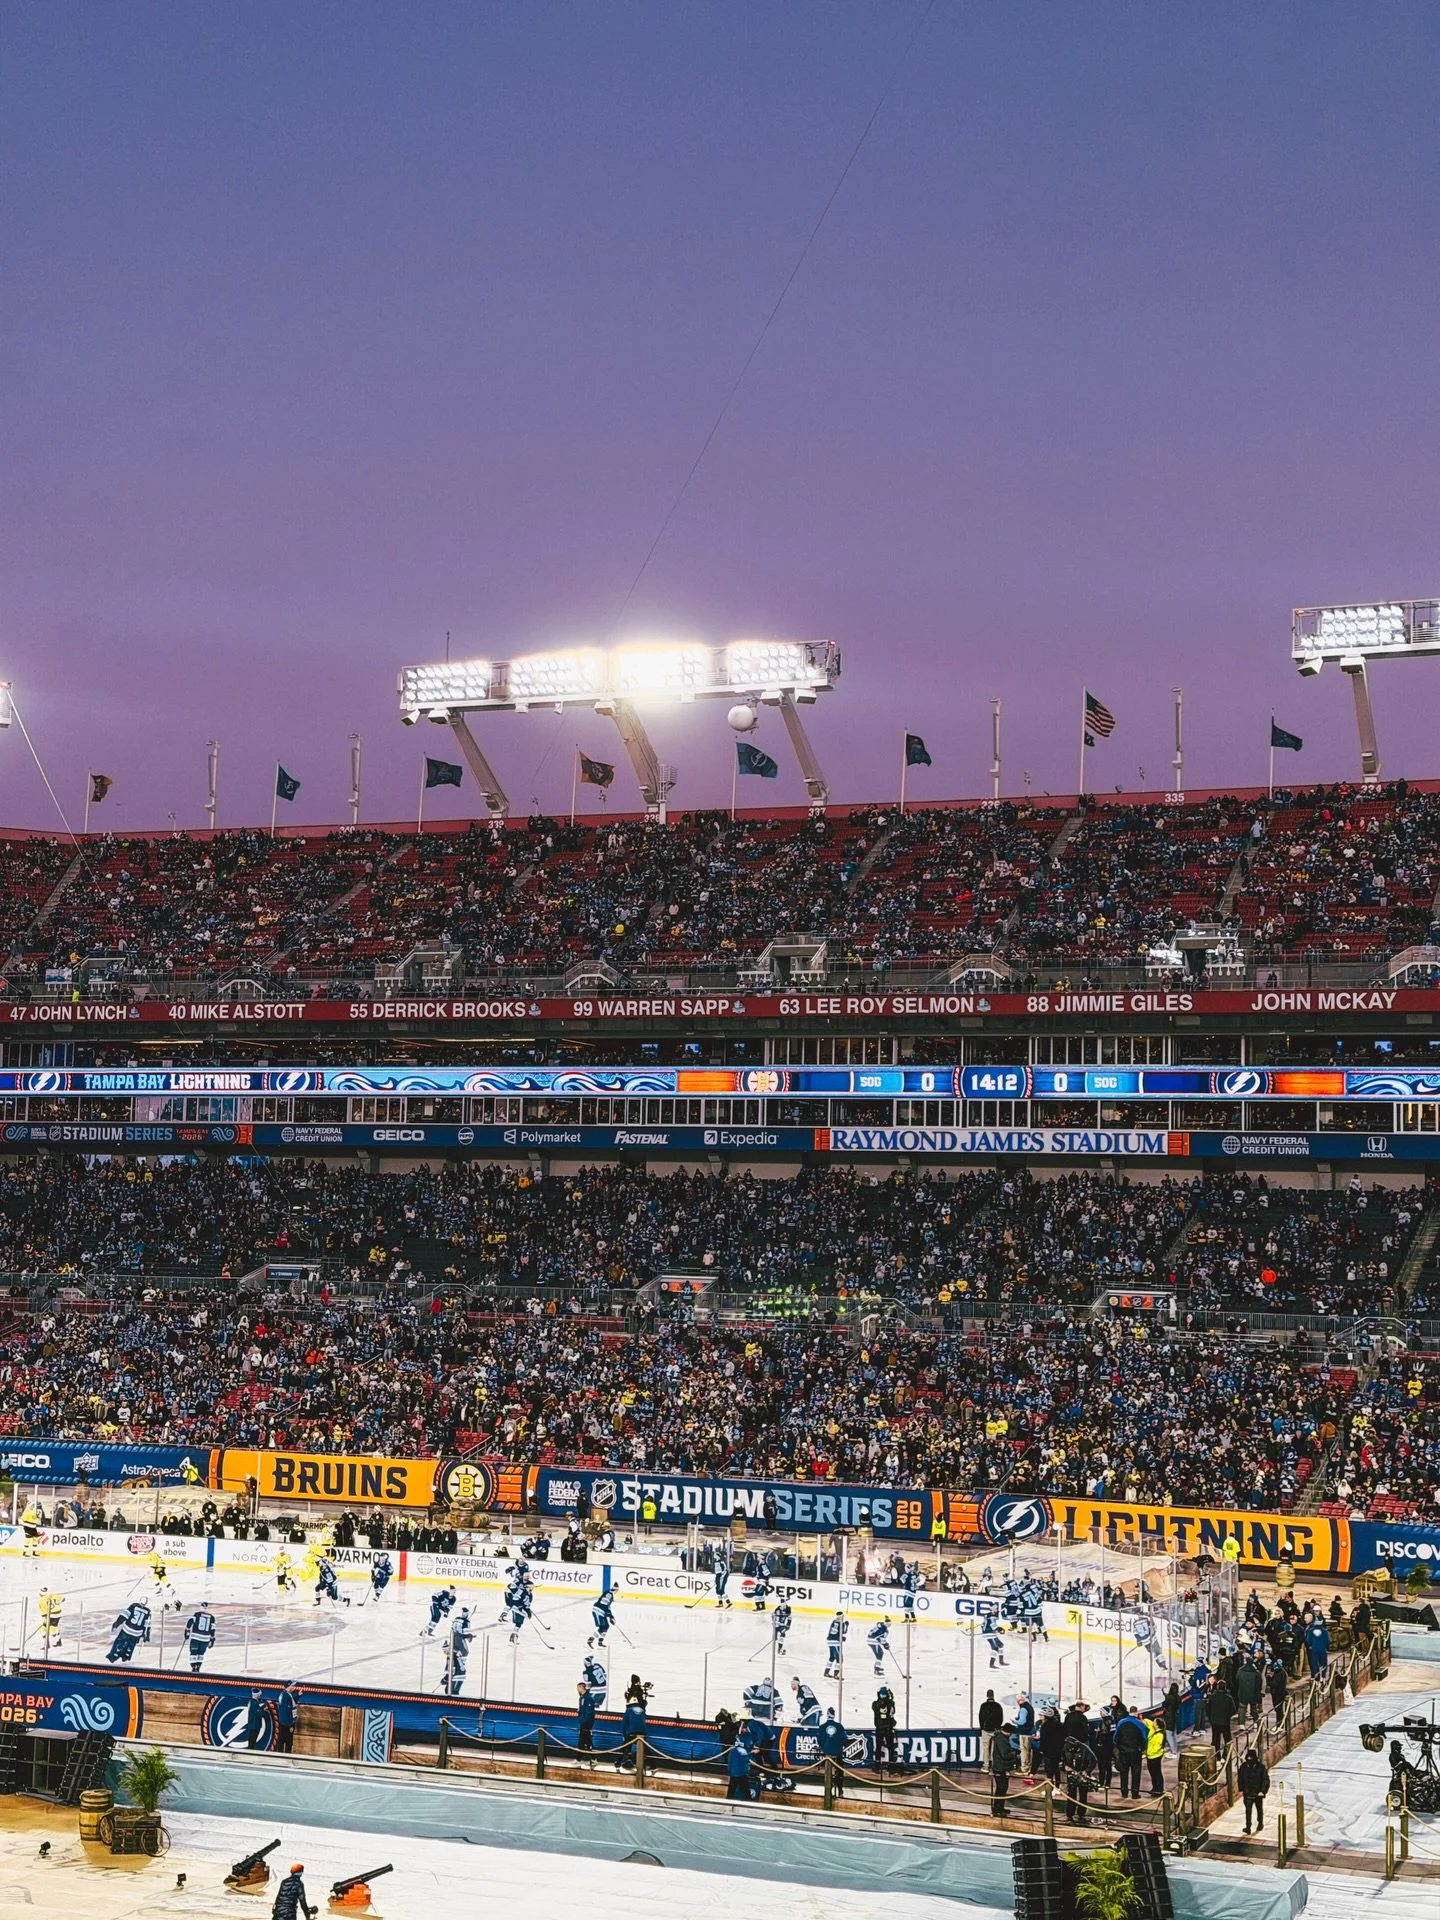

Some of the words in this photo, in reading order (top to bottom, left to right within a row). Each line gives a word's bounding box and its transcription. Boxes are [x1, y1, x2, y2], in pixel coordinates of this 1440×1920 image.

[1164, 792, 1185, 803] 335
[573, 1001, 593, 1017] 99
[599, 1000, 676, 1016] WARREN
[681, 999, 730, 1015] SAPP
[779, 999, 800, 1014] 63
[805, 998, 841, 1014] LEE
[847, 997, 887, 1013] ROY
[892, 997, 974, 1014] SELMON
[1027, 996, 1049, 1012] 88
[1055, 995, 1124, 1012] JIMMIE
[1130, 994, 1193, 1011] GILES
[1251, 993, 1311, 1011] JOHN
[1318, 992, 1397, 1010] MCKAY
[10, 1006, 27, 1020] 47
[30, 1005, 72, 1021] JOHN
[76, 1005, 127, 1020] LYNCH
[168, 1005, 186, 1019] 40
[190, 1004, 229, 1019] MIKE
[232, 1003, 306, 1019] ALSTOTT
[350, 1003, 368, 1018] 55
[372, 1002, 447, 1018] DERRICK
[452, 1002, 526, 1018] BROOKS
[84, 1074, 135, 1090] TAMPA
[138, 1074, 166, 1090] BAY
[170, 1073, 251, 1090] LIGHTNING
[860, 1076, 882, 1088] SOG
[921, 1072, 935, 1091] 0
[971, 1074, 1017, 1091] 14:12
[1054, 1072, 1068, 1091] 0
[1094, 1076, 1117, 1088] SOG
[63, 1126, 123, 1140] STADIUM
[125, 1126, 173, 1140] SERIES
[373, 1129, 425, 1141] GEICO
[521, 1131, 581, 1144] Polymarket
[615, 1131, 668, 1144] FASTENAL
[720, 1131, 777, 1146] Expedia
[1242, 1136, 1266, 1144] NAVY
[1269, 1136, 1309, 1145] FEDERAL
[832, 1130, 957, 1151] RAYMOND
[961, 1131, 1044, 1152] JAMES
[1051, 1132, 1165, 1154] STADIUM
[1242, 1146, 1276, 1154] CREDIT
[1278, 1147, 1309, 1155] UNION
[272, 1457, 407, 1499] BRUINS
[457, 1473, 475, 1497] B
[549, 1480, 571, 1489] NAVY
[549, 1488, 580, 1497] FEDERA
[596, 1484, 613, 1502] NHL
[621, 1481, 766, 1519] STADIUM
[548, 1499, 566, 1507] Credit
[896, 1500, 921, 1515] 20
[896, 1515, 921, 1529] 26
[52, 1532, 104, 1546] paloalto
[1061, 1506, 1314, 1564] LIGHTNING
[172, 1539, 186, 1547] sub
[163, 1547, 187, 1556] above
[435, 1556, 459, 1567] NAVY
[461, 1558, 498, 1569] FEDERAL
[435, 1567, 463, 1578] CREDIT
[467, 1569, 498, 1579] UNION
[625, 1571, 670, 1588] Great
[674, 1575, 711, 1593] Clips
[765, 1584, 812, 1600] PEPSI
[26, 1695, 54, 1708] BAY
